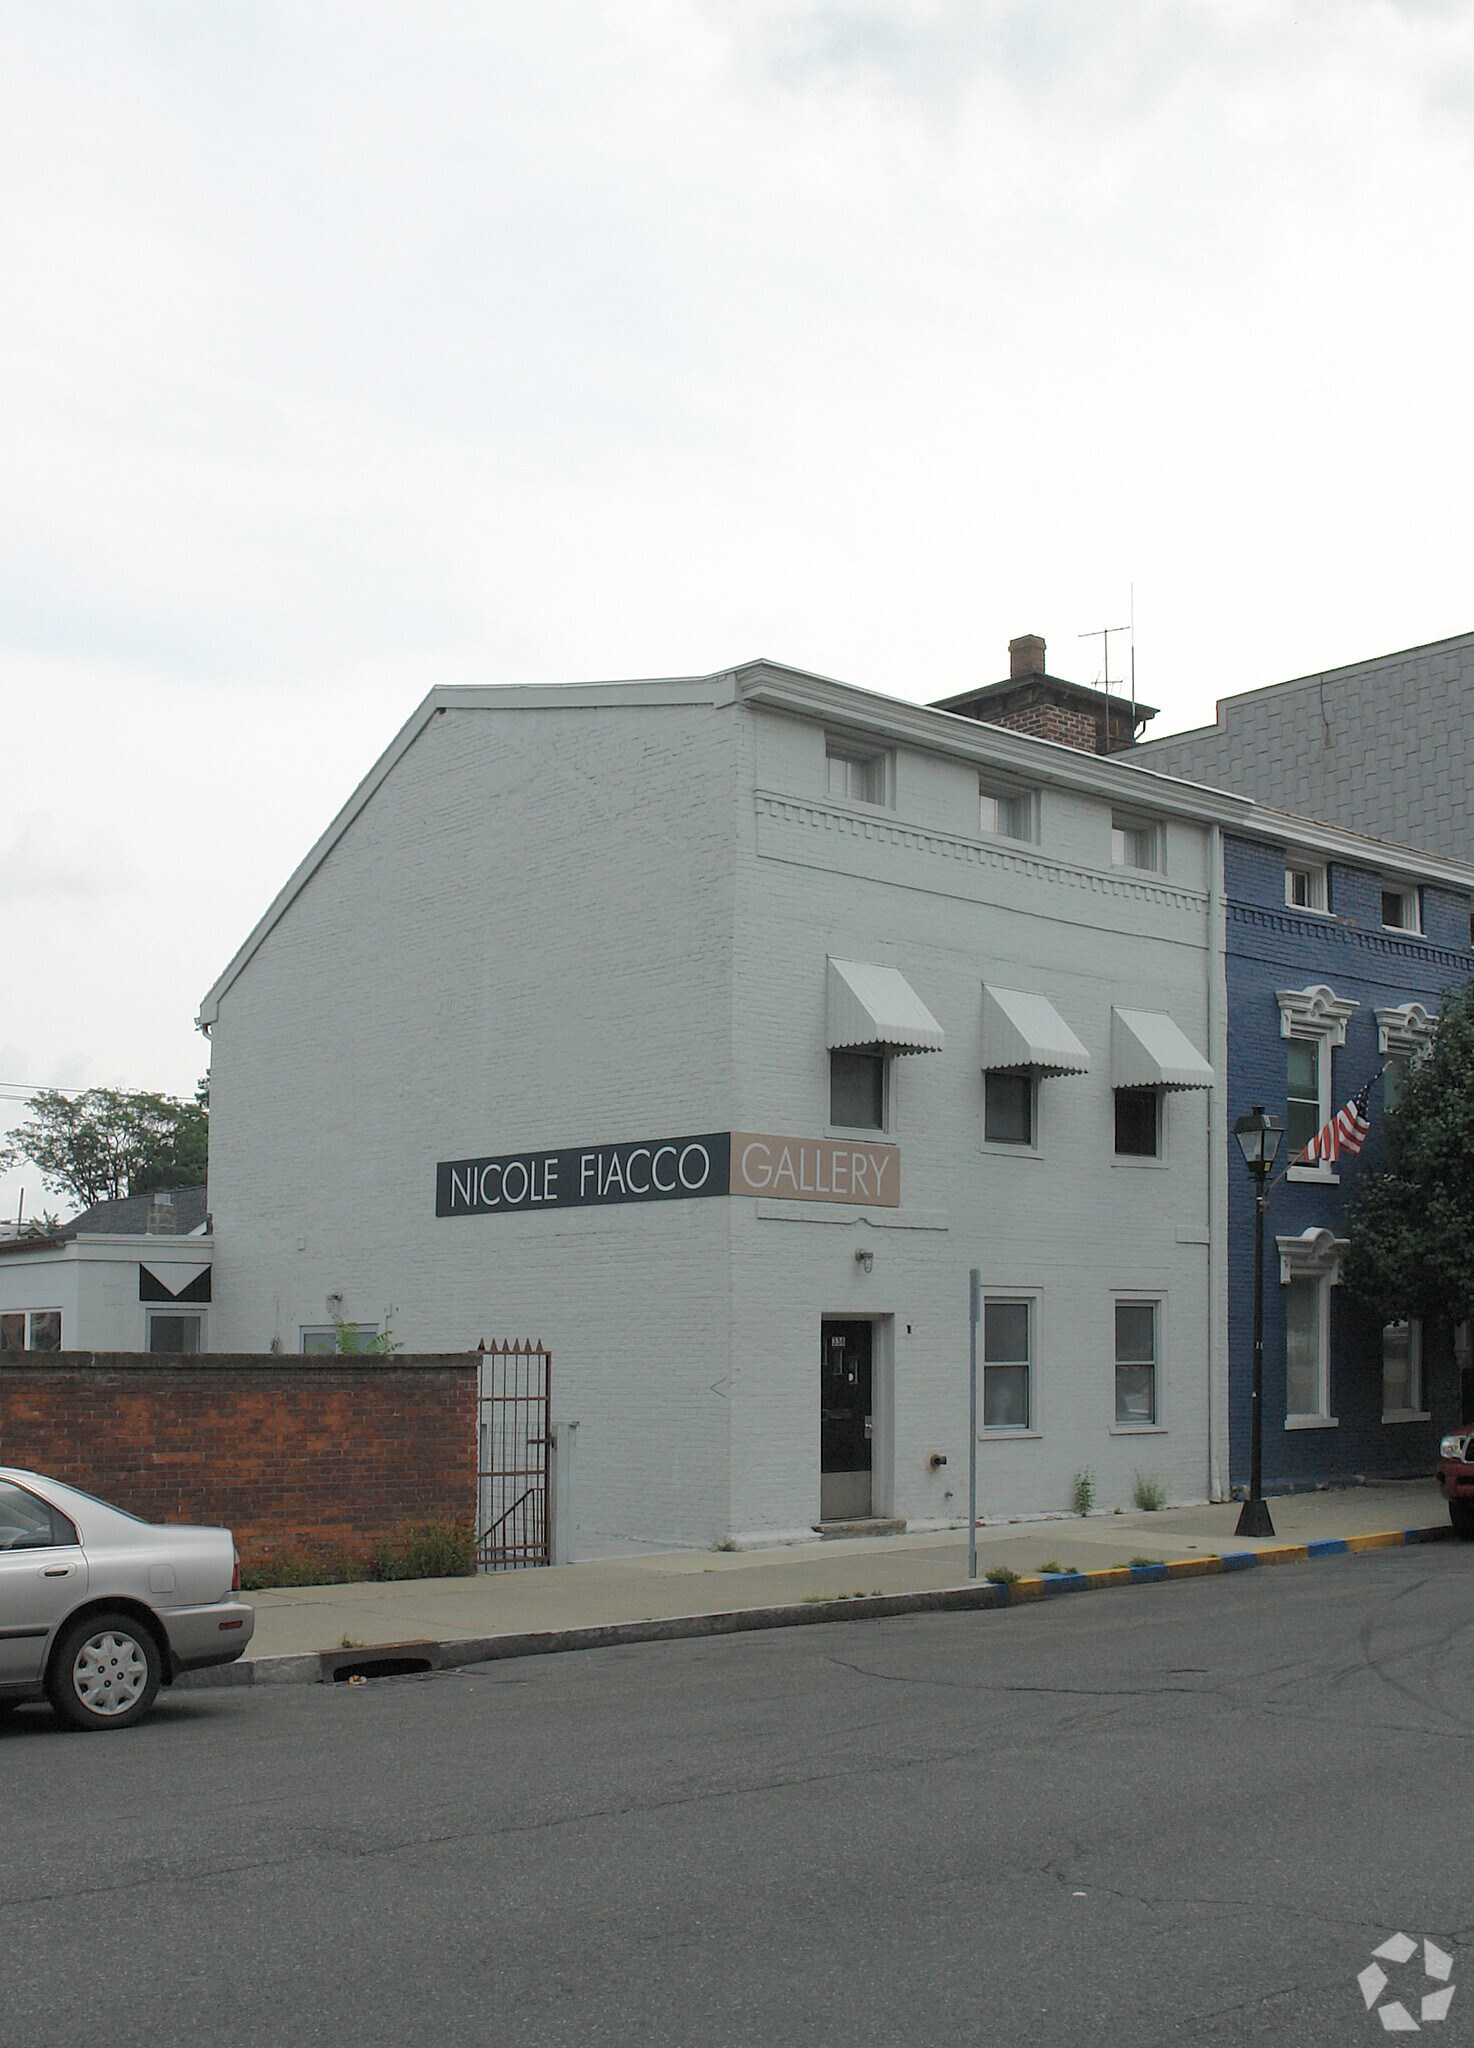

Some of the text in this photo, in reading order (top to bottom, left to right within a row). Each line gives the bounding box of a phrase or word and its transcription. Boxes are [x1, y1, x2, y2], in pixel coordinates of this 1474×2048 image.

[451, 1143, 710, 1207] NICOLE FIACCO
[741, 1142, 890, 1196] GALLERY
